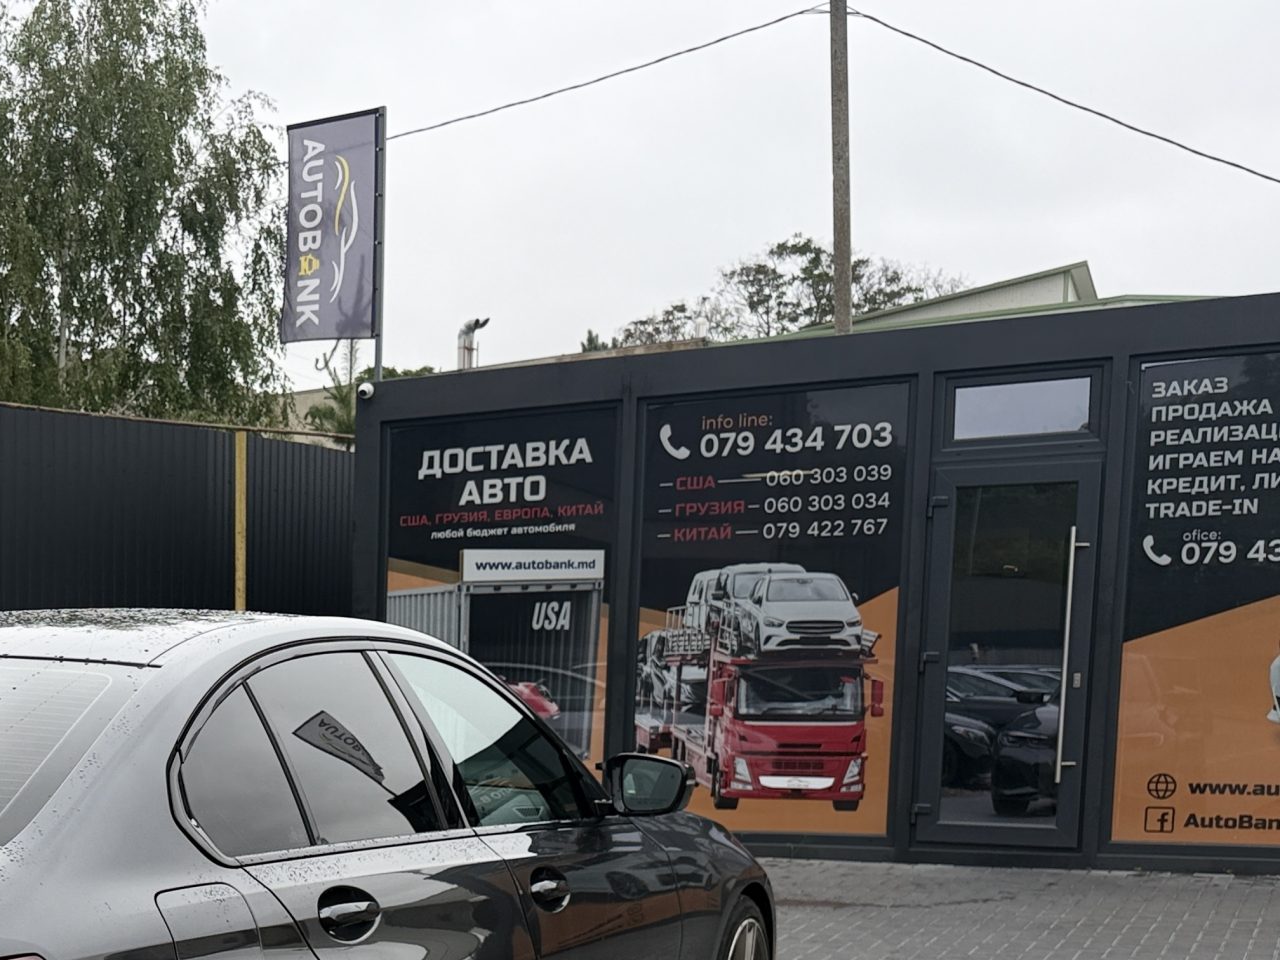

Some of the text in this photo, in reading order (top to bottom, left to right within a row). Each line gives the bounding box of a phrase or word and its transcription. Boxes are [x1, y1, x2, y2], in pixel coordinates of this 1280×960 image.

[1151, 376, 1229, 398] ЗАКАЗ
[1151, 398, 1273, 423] ПРОДАЖА
[702, 413, 773, 431] info line:
[699, 421, 893, 458] 079 434 703
[1150, 422, 1280, 447] РЕАЛИЗАЦ
[417, 437, 593, 480] ДОСТАВКА
[1148, 447, 1280, 471] ИГРАЕМ НА
[676, 475, 716, 491] США
[766, 464, 892, 487] 060 303 039
[1147, 474, 1246, 496] КРЕДИТ,
[458, 475, 547, 506] АВТО
[399, 501, 604, 527] США, ГРУЗИЯ, ЕВРОПА, КИТАЙ
[674, 500, 745, 517] ГРУЗИЯ
[764, 492, 891, 514] 060 303 034
[1145, 498, 1259, 519] TRADE-IN
[431, 522, 576, 540] любой бюджет автомобиля
[673, 523, 732, 542] КИТАЙ
[762, 518, 888, 539] 079 422 767
[1182, 529, 1222, 542] ofice:
[1180, 538, 1280, 565] 079 43
[475, 559, 596, 571] www.autobank.md
[531, 601, 572, 631] USA
[1188, 782, 1280, 796] www.au
[1184, 813, 1280, 830] AutoBan
